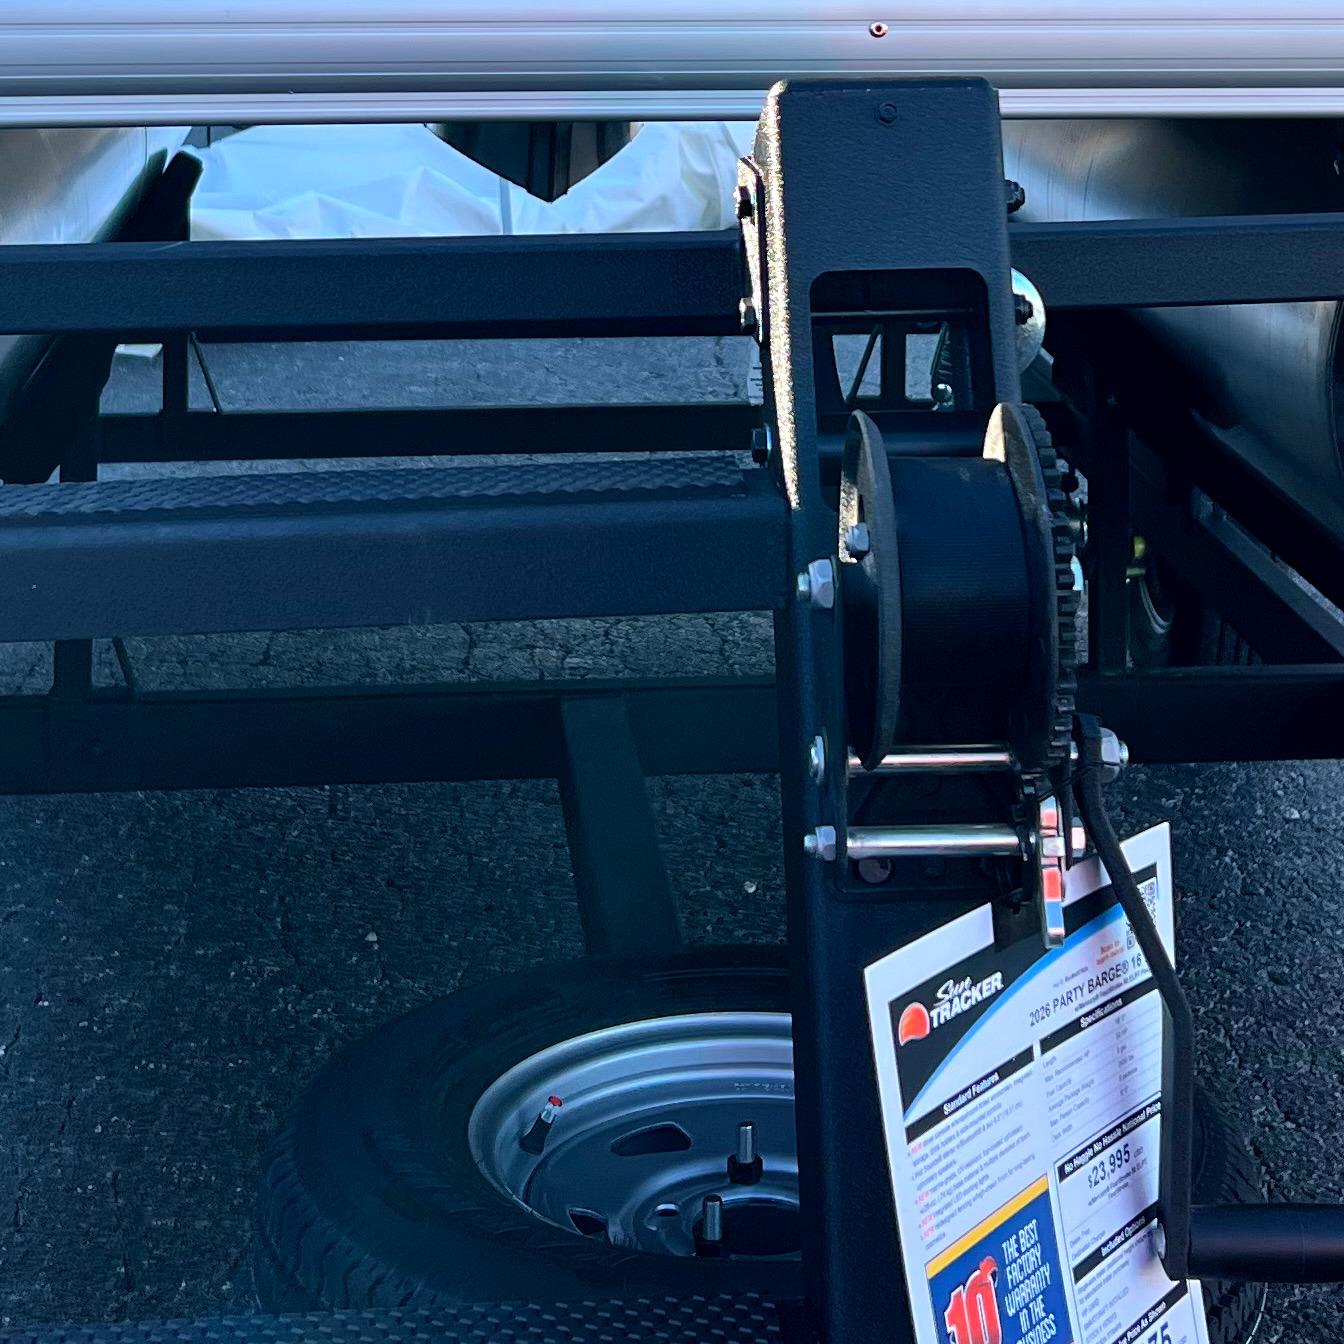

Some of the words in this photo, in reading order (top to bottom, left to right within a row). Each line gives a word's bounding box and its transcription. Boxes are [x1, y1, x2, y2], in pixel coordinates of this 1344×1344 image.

[930, 971, 1004, 1028] TRACKER
[933, 976, 972, 1008] Sun
[1029, 1002, 1051, 1027] 2026
[1052, 983, 1086, 1014] PARTY
[1087, 1143, 1131, 1189] $23,995
[1001, 1234, 1020, 1265] THE
[1018, 1218, 1039, 1253] BEST
[1006, 1241, 1042, 1290] FACTORY
[1004, 1261, 1051, 1317] WARRANTY
[1018, 1307, 1031, 1334] IN
[1029, 1294, 1047, 1325] THE
